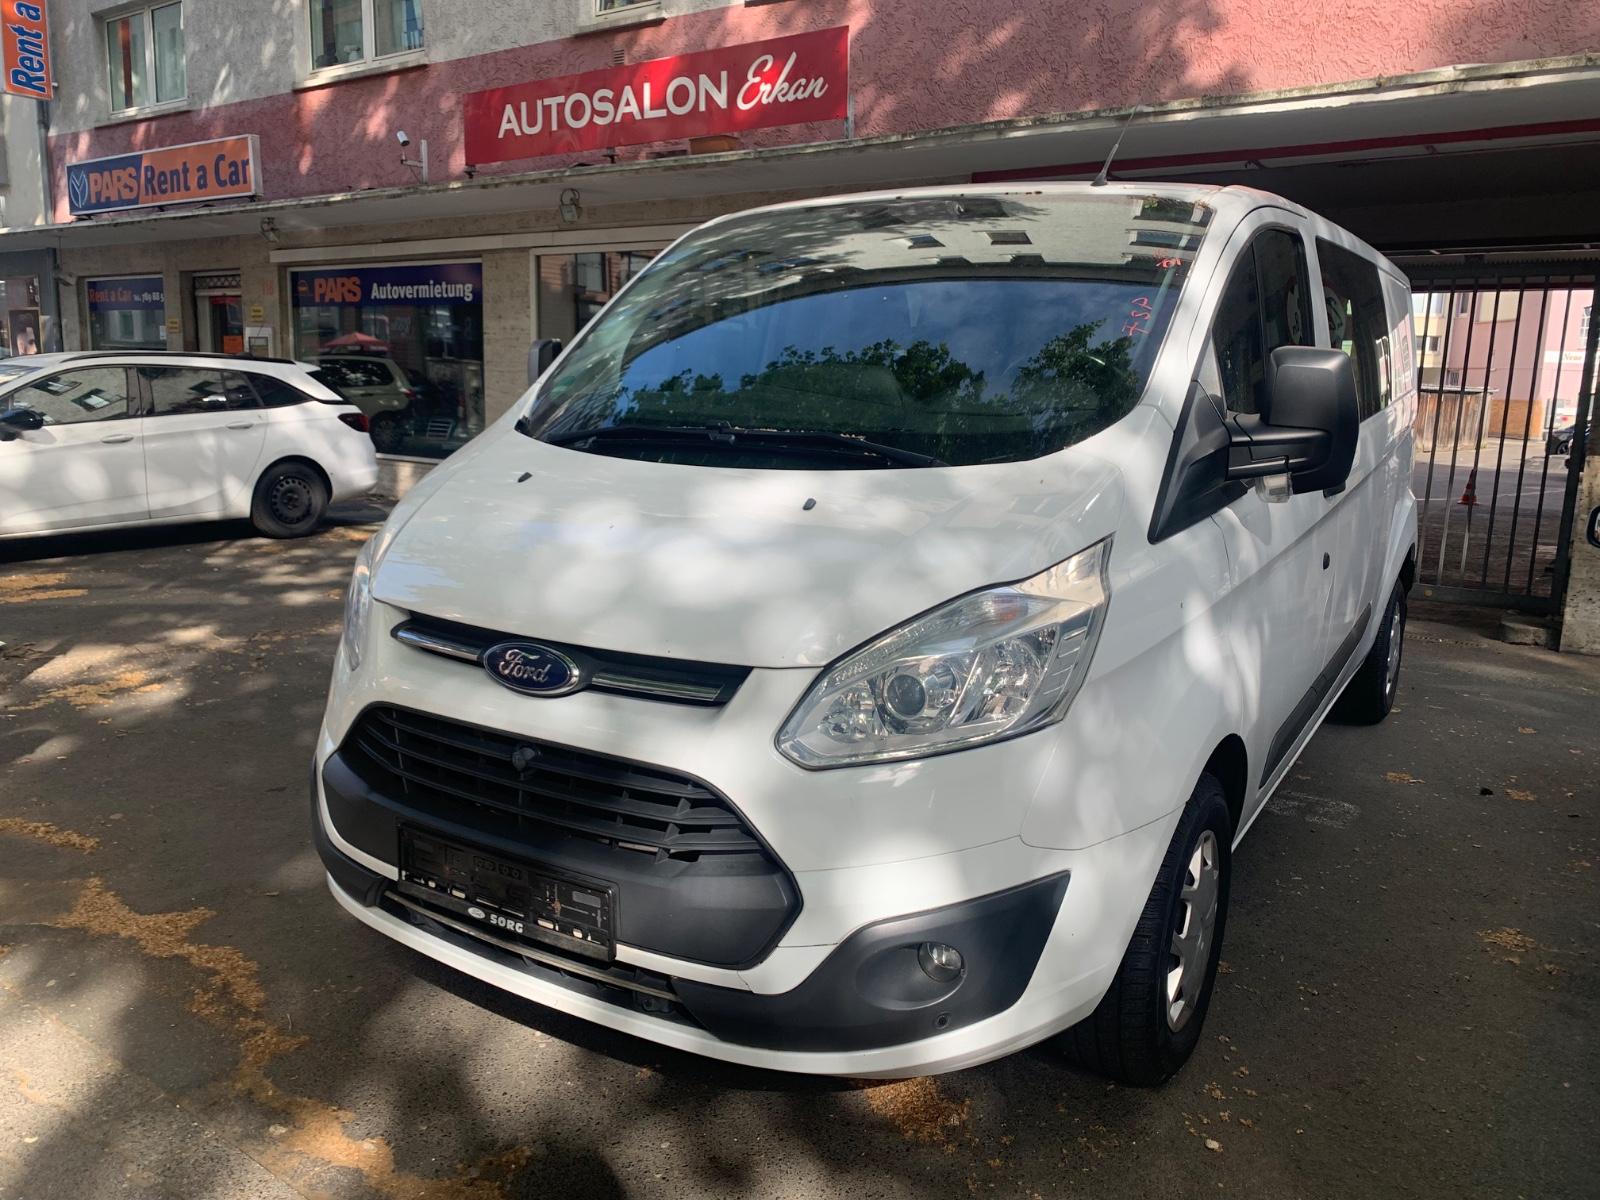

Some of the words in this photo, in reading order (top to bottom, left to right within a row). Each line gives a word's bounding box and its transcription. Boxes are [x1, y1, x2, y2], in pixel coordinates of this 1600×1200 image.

[14, 1, 42, 22] a
[8, 24, 47, 94] Rent
[498, 70, 728, 139] AUTOSALON
[737, 52, 829, 111] Erkan
[88, 167, 139, 203] PARS
[144, 161, 190, 196] Rent
[197, 164, 208, 190] a
[215, 154, 249, 188] Car
[88, 288, 109, 303] Rent
[314, 276, 362, 303] PARS
[371, 280, 473, 301] Autovermietung
[498, 648, 552, 683] Ford
[490, 913, 524, 934] SORG
